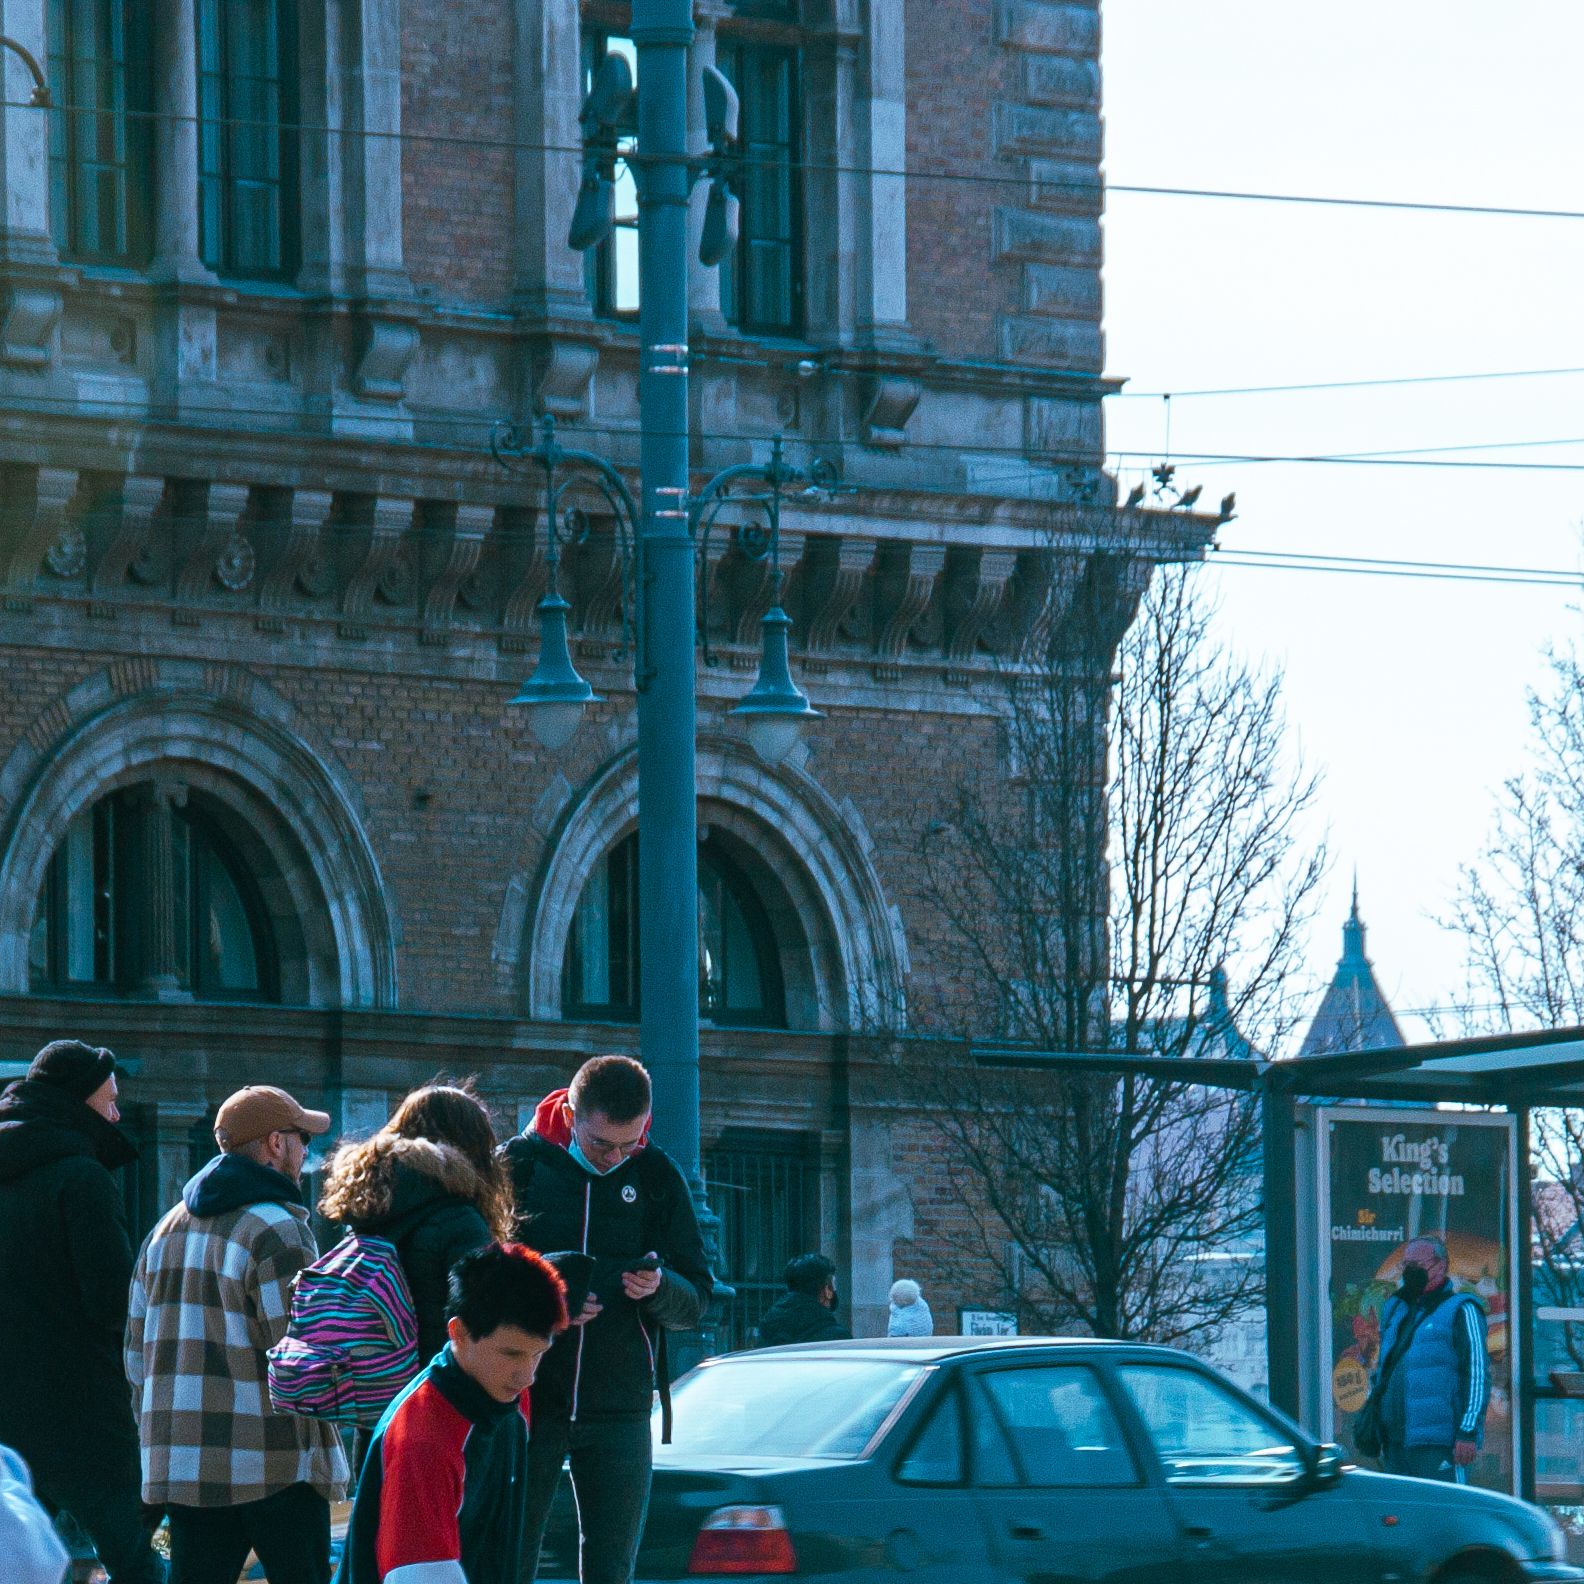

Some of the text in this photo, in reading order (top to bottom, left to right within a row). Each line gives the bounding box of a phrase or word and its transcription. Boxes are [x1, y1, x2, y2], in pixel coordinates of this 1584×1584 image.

[1382, 1134, 1449, 1170] King's
[1368, 1167, 1464, 1195] Selection
[1358, 1208, 1376, 1223] Sir
[1331, 1225, 1404, 1241] Chimichurri
